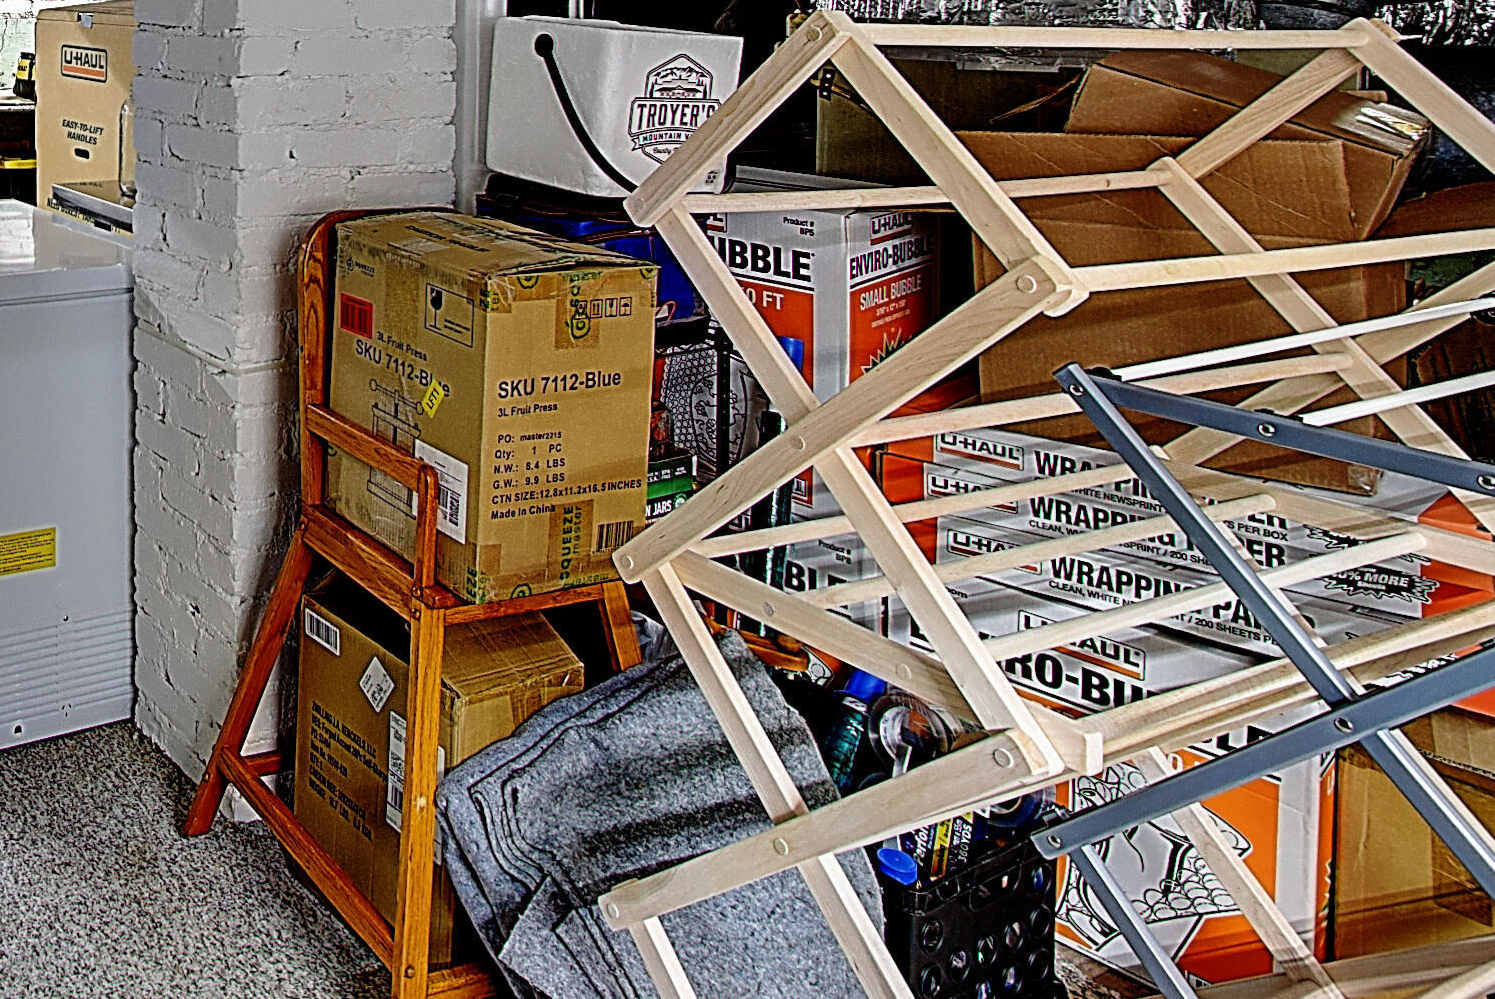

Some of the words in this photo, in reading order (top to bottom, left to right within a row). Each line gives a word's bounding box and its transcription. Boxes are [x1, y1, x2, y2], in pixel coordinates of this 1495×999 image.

[64, 49, 106, 70] U-HAUL
[62, 119, 104, 136] EASY-TO-LIFT
[637, 103, 715, 131] TROYER'S
[67, 131, 98, 146] HANDLES
[642, 132, 682, 142] MOUNTAIN
[783, 217, 809, 227] Product
[708, 236, 813, 282] UBBLE
[849, 237, 935, 280] ENVIRO-BUBBLE
[762, 290, 785, 311] FT
[860, 287, 889, 311] SMALL
[890, 275, 922, 300] BUBBLE
[377, 331, 386, 341] 3L
[387, 336, 405, 351] Fruit
[406, 344, 427, 361] Press
[356, 340, 382, 365] SKU
[386, 353, 450, 398] 7112-Ble
[498, 378, 535, 399] SKU
[541, 370, 622, 394] 7112-Blue
[498, 407, 509, 417] 3L
[511, 405, 531, 417] Fruit
[533, 402, 558, 413] Press
[497, 434, 515, 444] PO:
[940, 433, 1021, 462] U-HAUL
[495, 450, 515, 461] Qty:
[549, 443, 562, 453] PC
[525, 461, 540, 470] 8.4
[546, 458, 566, 468] LBS
[525, 476, 539, 486] 9.9
[546, 473, 565, 483] LBS
[491, 493, 512, 504] CTN
[608, 479, 642, 491] INCHES
[491, 509, 516, 519] Made
[529, 504, 556, 515] China
[653, 500, 672, 516] JARS
[1104, 492, 1165, 513] NEWSPRINT
[1237, 522, 1262, 535] PER
[1263, 527, 1289, 542] BOX
[560, 505, 573, 581] SQUEEZE
[1169, 550, 1188, 561] 200
[1050, 556, 1197, 599] WRAPPIN
[1364, 572, 1409, 587] MORE
[1049, 580, 1087, 599] CLEAN,
[1087, 589, 1121, 604] WHITE
[1194, 617, 1214, 629] 200
[1216, 622, 1261, 641] SHEETS
